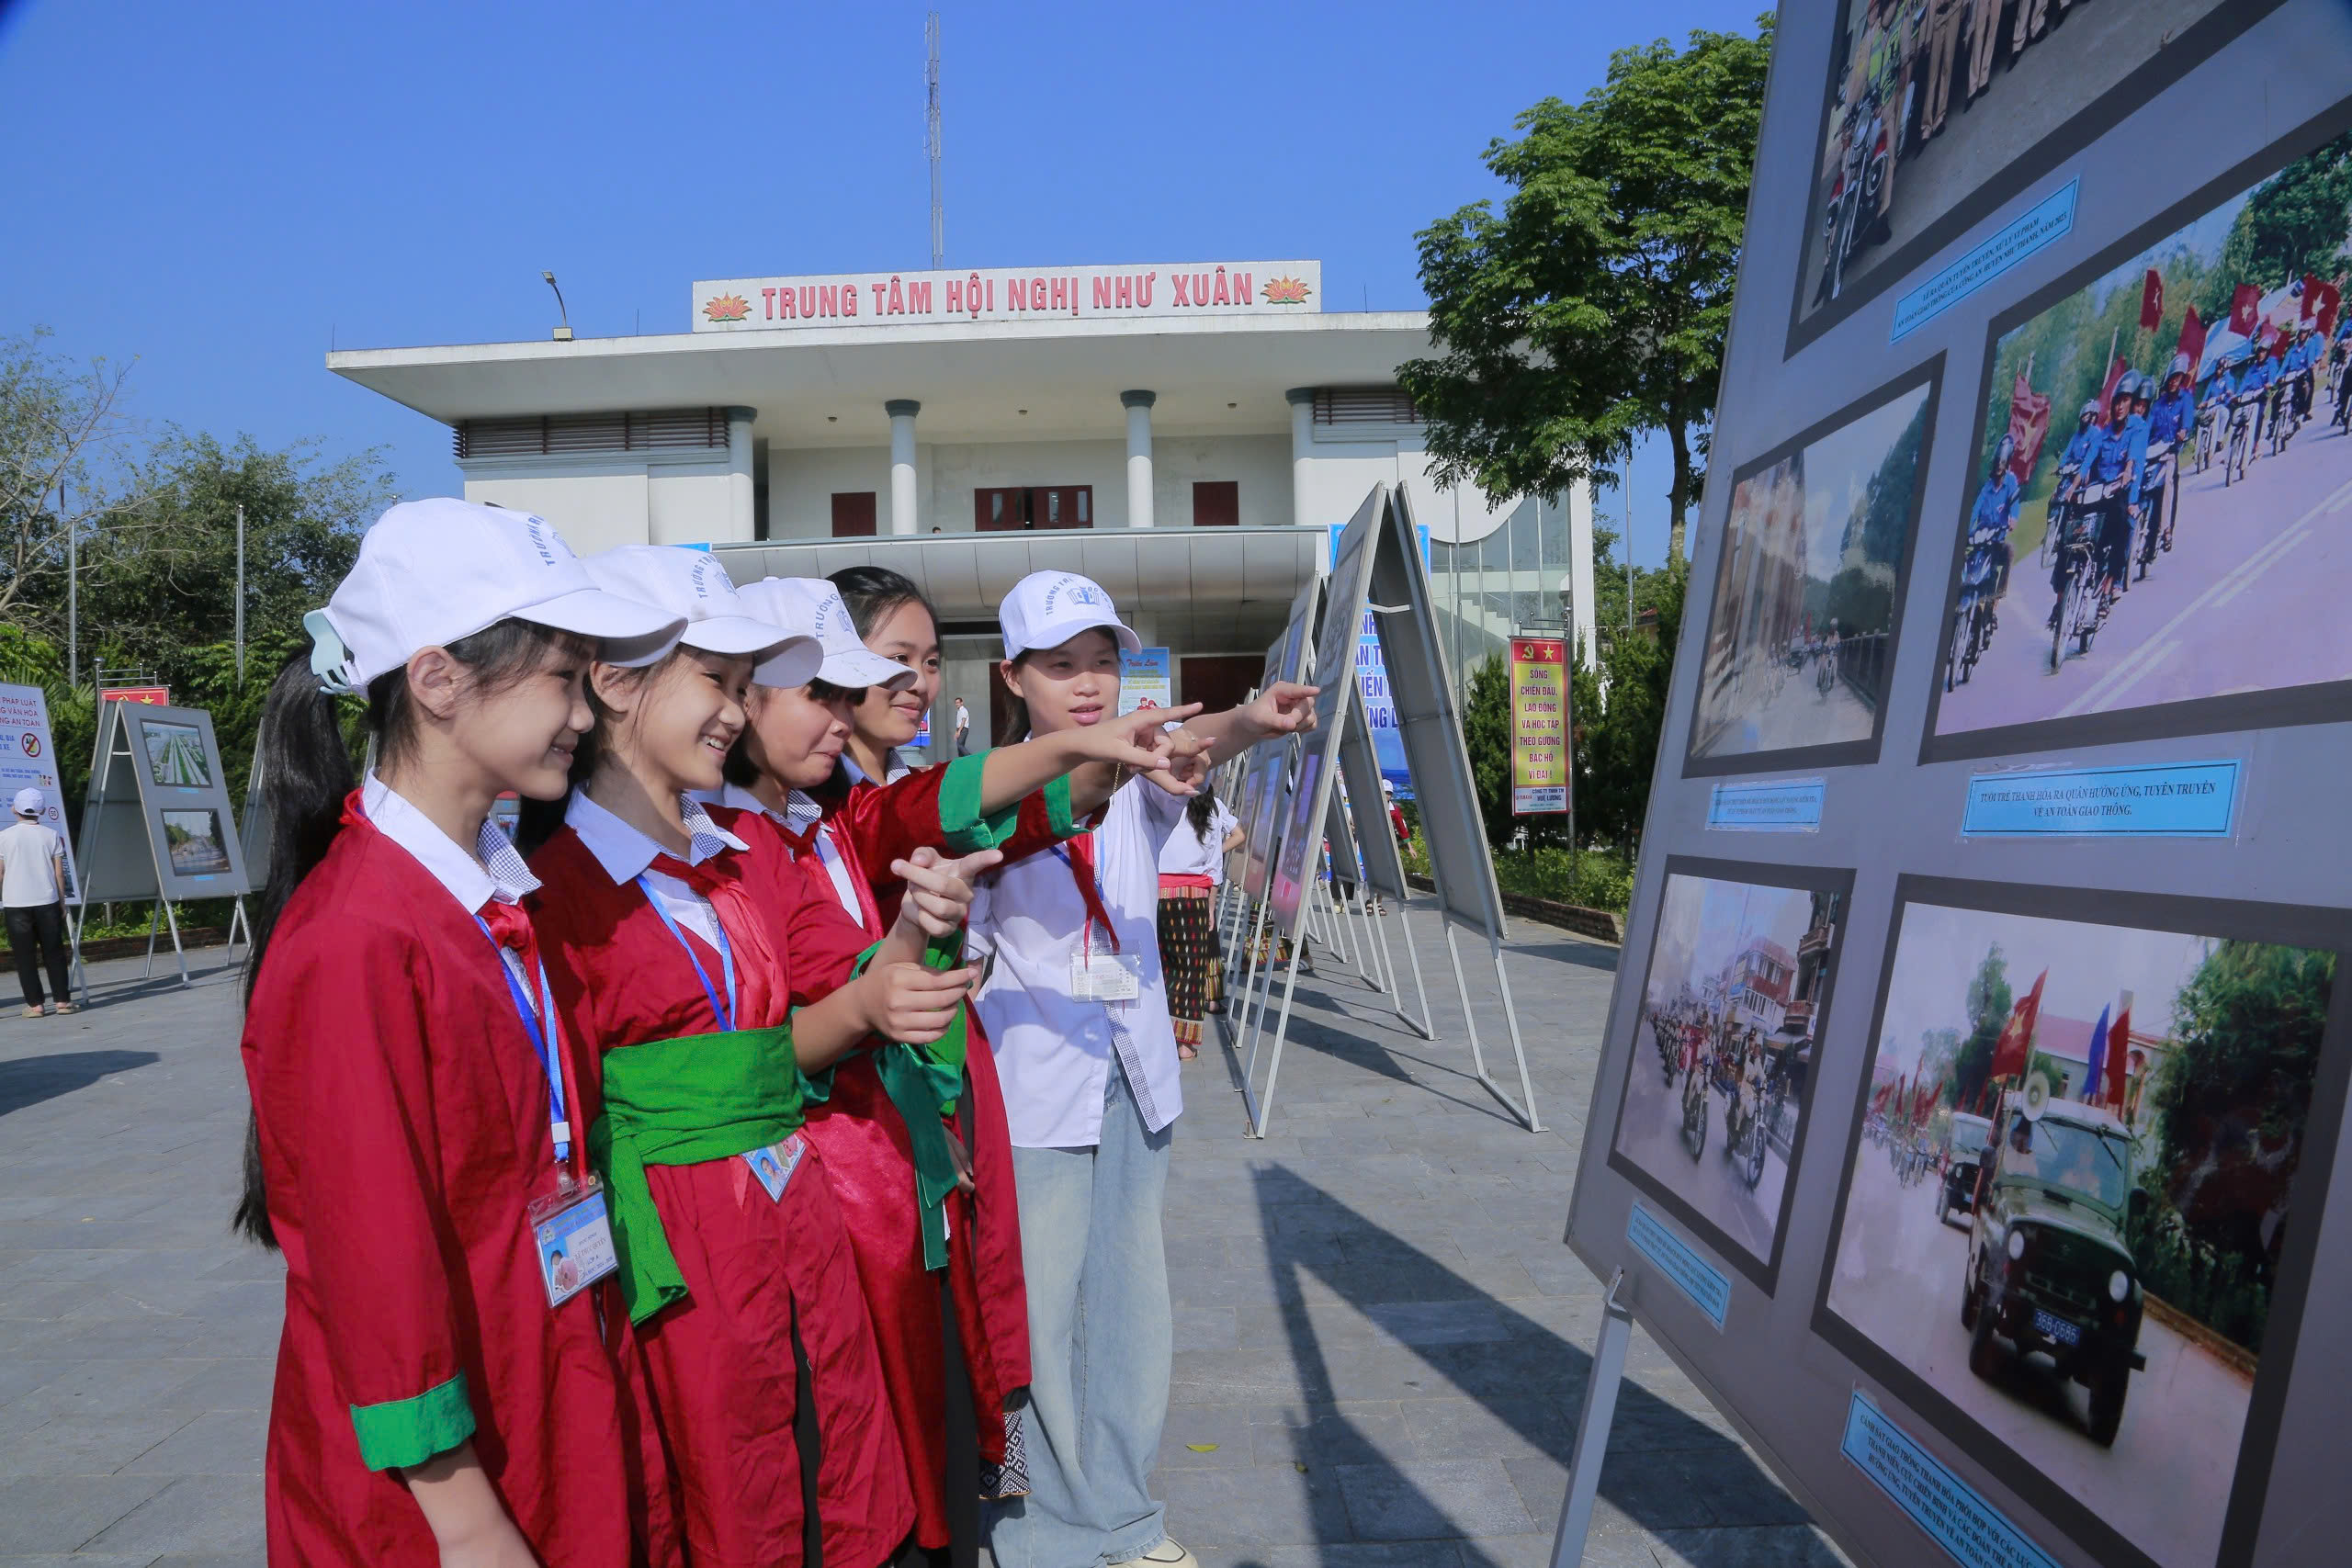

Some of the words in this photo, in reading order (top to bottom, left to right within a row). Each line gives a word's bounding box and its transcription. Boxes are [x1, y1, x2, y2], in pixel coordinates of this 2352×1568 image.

[762, 281, 858, 320] TRUNG
[872, 277, 933, 316] TÂM
[946, 272, 994, 319] HỘI
[1009, 276, 1079, 316] NGHỊ
[1093, 270, 1156, 309] NHƯ
[1171, 265, 1253, 306] XUÂN
[1530, 667, 1548, 679] SỐNG
[1521, 684, 1541, 695] CHIẾN
[1524, 703, 1537, 712] LAO
[1538, 701, 1556, 714] ĐỘNG
[1532, 719, 1545, 730] HỌC
[1546, 718, 1560, 730] TẬP
[1520, 737, 1536, 745] THEO
[1529, 751, 1543, 761] BÁC
[2011, 791, 2035, 802] THANH
[2052, 789, 2064, 799] RA
[2064, 785, 2088, 802] QUÂN
[2143, 781, 2175, 796] TUYÊN
[2176, 780, 2217, 795] TRUYỀN
[2045, 807, 2056, 817] AN
[2057, 804, 2077, 817] TOÀN
[2078, 805, 2099, 817] GIAO
[1860, 1414, 1875, 1433] CẢNH
[1885, 1437, 1900, 1454] GIAO
[1900, 1449, 1920, 1472] THÔNG
[1920, 1466, 1941, 1492] THANH
[1955, 1498, 1972, 1518] PHỐI
[1972, 1514, 1986, 1530] HỢP
[1987, 1526, 2000, 1544] VỚI
[2000, 1539, 2016, 1557] CÁC
[1868, 1436, 1886, 1459] THANH
[1914, 1478, 1932, 1499] CHIẾN
[1958, 1518, 1971, 1536] CÁC
[1972, 1531, 1991, 1553] ĐOÀN
[1902, 1483, 1920, 1506] TUYÊN
[1921, 1502, 1945, 1529] TRUYỀN
[1955, 1535, 1965, 1548] AN
[1965, 1542, 1984, 1565] TOÀN
